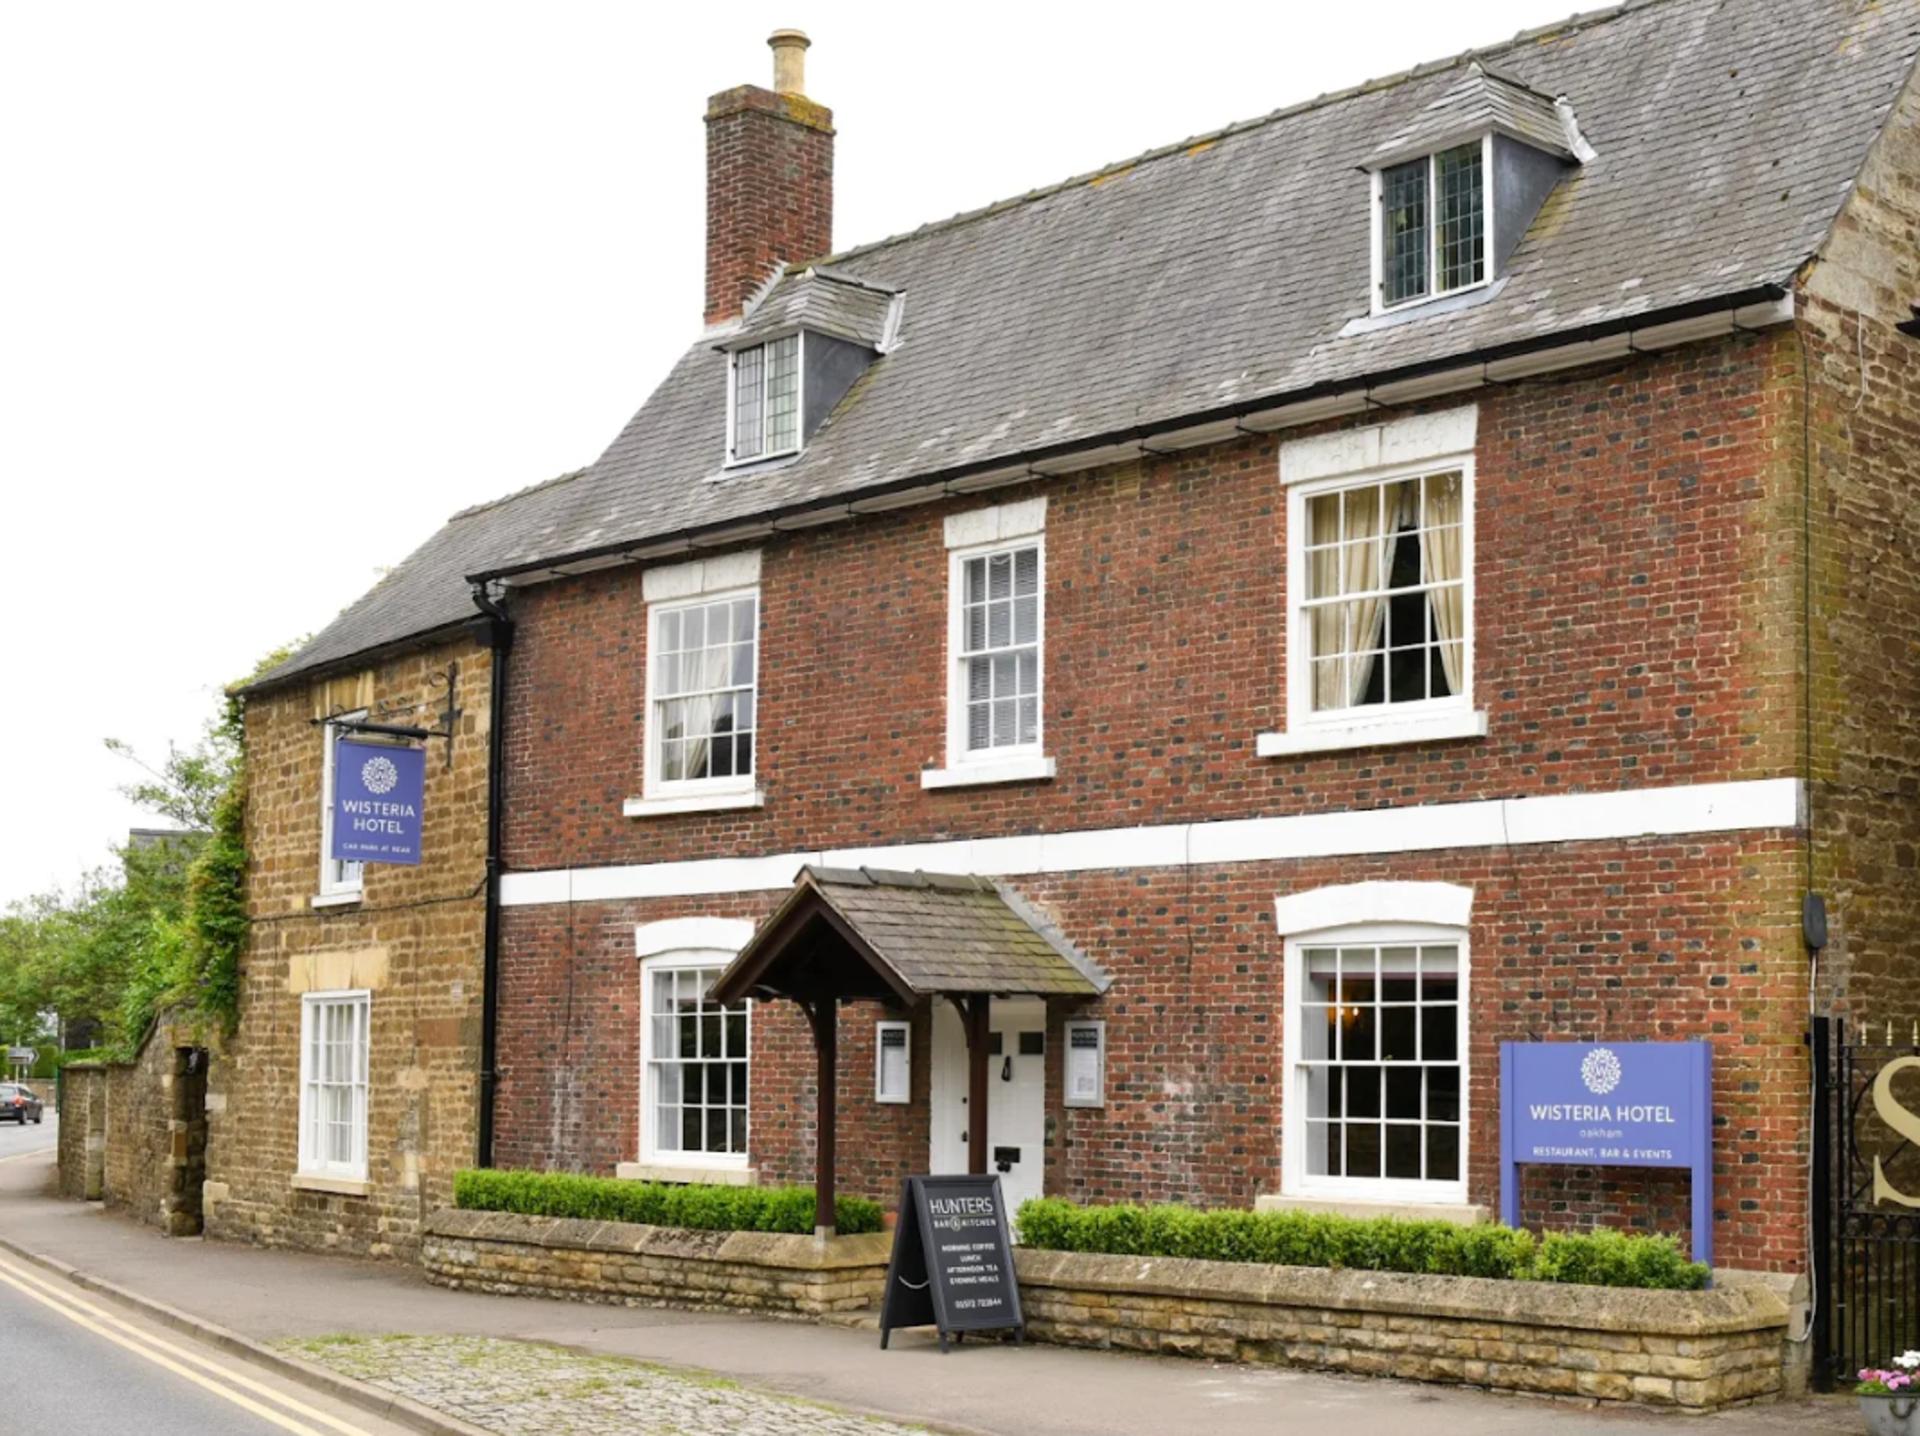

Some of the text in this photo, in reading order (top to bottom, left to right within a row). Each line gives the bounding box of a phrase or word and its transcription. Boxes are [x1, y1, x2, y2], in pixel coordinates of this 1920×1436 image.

[342, 799, 415, 817] WISTERIA
[353, 817, 404, 834] HOTEL
[342, 842, 411, 854] CAR PARK AT REAR
[1530, 1104, 1675, 1123] WISTERIA HOTEL
[1579, 1128, 1623, 1139] oakham
[1533, 1146, 1673, 1160] RESTAURANT, BAR & EVENTS
[929, 1196, 993, 1214] HUNTERS
[934, 1219, 950, 1228] BAR
[961, 1218, 996, 1227] KITCHEN
[942, 1244, 970, 1252] MORNING
[960, 1254, 981, 1262] LUNCH
[947, 1265, 984, 1273] AFTERNOON
[950, 1276, 976, 1285] EVENING
